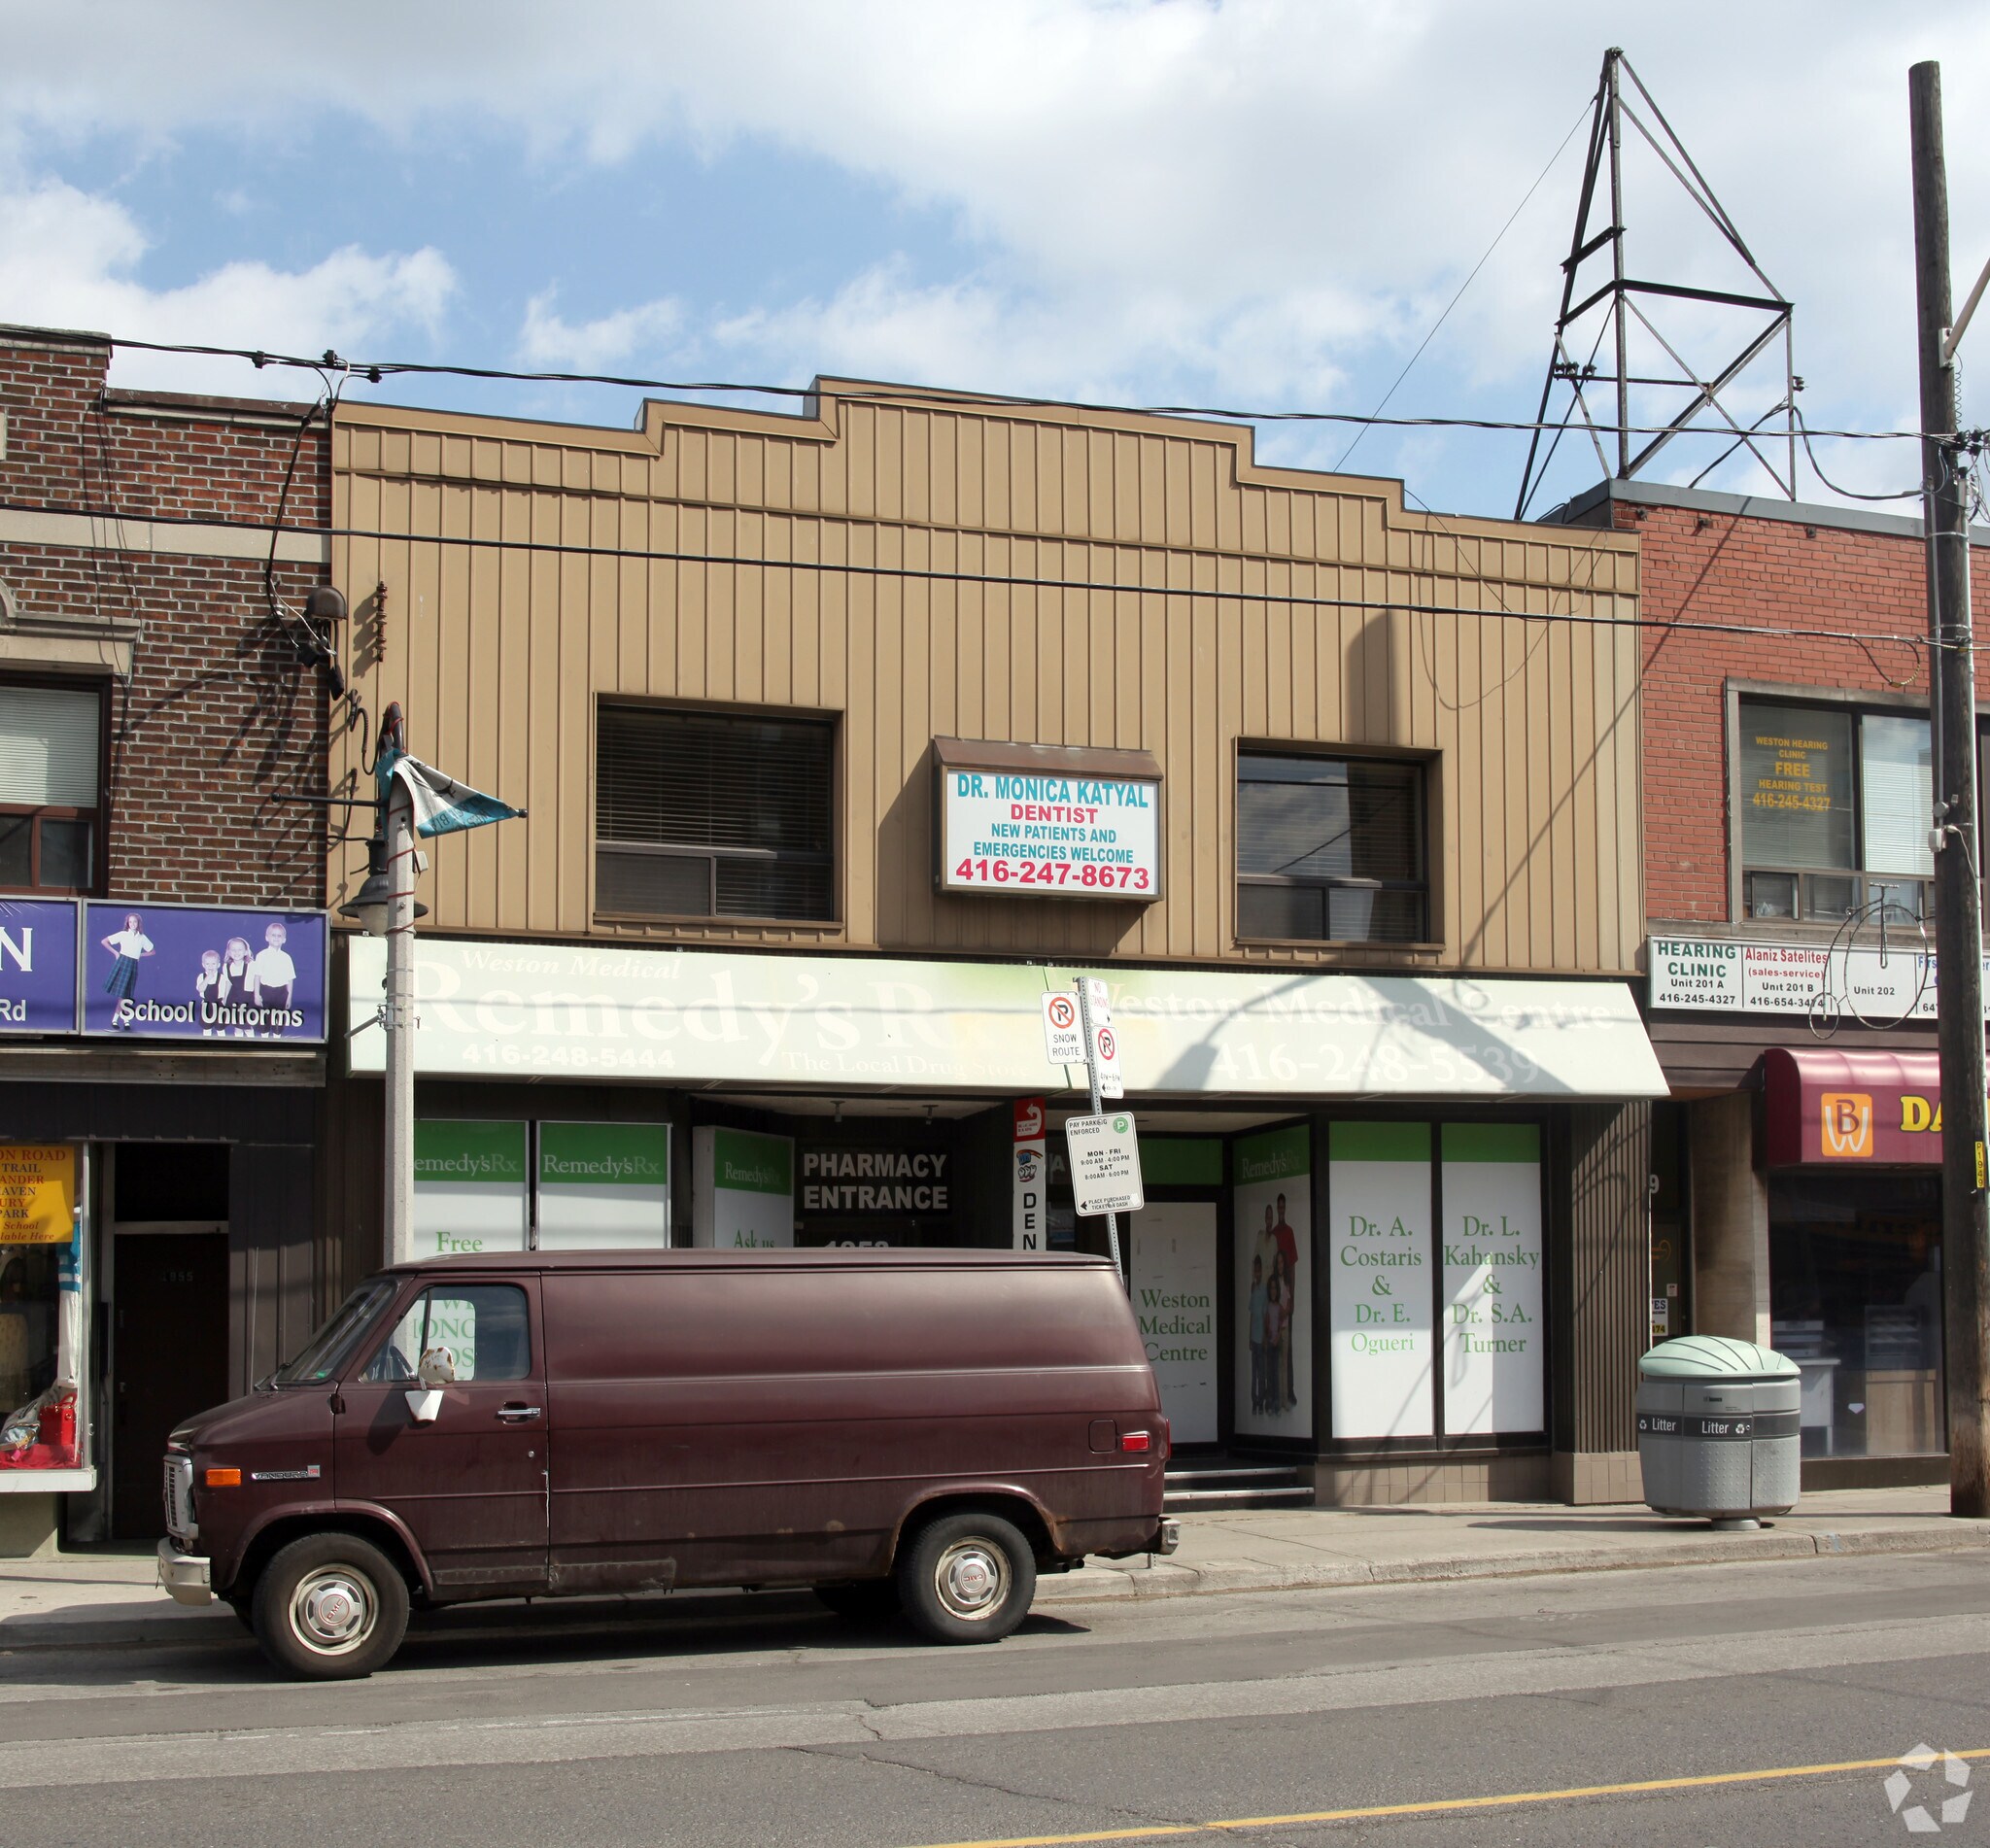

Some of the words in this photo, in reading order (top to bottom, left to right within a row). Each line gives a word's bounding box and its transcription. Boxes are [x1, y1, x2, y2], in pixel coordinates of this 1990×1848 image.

[1755, 736, 1790, 748] WESTON
[1791, 737, 1828, 750] HEARING
[1778, 749, 1806, 760] CLINIC
[1774, 762, 1811, 777] FREE
[957, 773, 989, 799] DR.
[995, 776, 1072, 804] MONICA
[1077, 780, 1149, 808] KATYAL
[1758, 778, 1801, 792] HEARING
[1803, 781, 1828, 793] TEST
[1752, 793, 1832, 811] 416-245-4327
[1011, 804, 1099, 824] DENTIST
[991, 823, 1021, 838] NEW
[1024, 825, 1086, 842] PATIENTS
[1089, 829, 1116, 843] AND
[974, 840, 1067, 861] EMERGENCIES
[1070, 846, 1134, 864] WELCOME
[955, 858, 1149, 890] 416-247-8673
[1658, 942, 1736, 960] HEARING
[1745, 947, 1777, 963] Alaniz
[1780, 948, 1829, 965] Satelites
[461, 949, 560, 975] Weston
[568, 955, 682, 979] Medical
[1667, 962, 1727, 978] CLINIC
[1748, 968, 1826, 980] (sales-service)
[1670, 978, 1693, 988] Unit
[1696, 979, 1714, 988] 201
[1717, 980, 1725, 989] A
[1762, 982, 1783, 992] Unit
[1786, 983, 1804, 992] 201
[1854, 986, 1876, 996] Unit
[1879, 986, 1896, 996] 202
[1257, 985, 1454, 1028] Medical
[1660, 993, 1735, 1005] 416-245-4327
[120, 998, 194, 1024] School
[200, 1001, 304, 1028] Uniforms
[1053, 1034, 1078, 1044] SNOW
[462, 1044, 676, 1070] 416-248-5444
[1051, 1046, 1081, 1057] ROUTE
[782, 1051, 832, 1073] The
[837, 1053, 901, 1075] Local
[905, 1056, 966, 1079] Drug
[1210, 1042, 1538, 1085] 416-248-5539
[1070, 1127, 1100, 1136] ENFORCED
[21, 1149, 66, 1161] ROAD
[2, 1163, 42, 1173] TRAIL
[803, 1153, 948, 1178] PHARMACY
[803, 1185, 948, 1210] ENTRANCE
[1104, 1195, 1130, 1204] PURCHASED
[3, 1221, 39, 1230] School
[1349, 1215, 1382, 1237] Dr.
[1389, 1215, 1413, 1237] A.
[1462, 1215, 1494, 1237] Dr.
[1500, 1215, 1521, 1237] L.
[30, 1232, 55, 1241] Here
[435, 1231, 483, 1252] Free
[735, 1229, 758, 1248] Ask
[762, 1239, 775, 1248] us
[1340, 1245, 1423, 1267] Costaris
[1444, 1244, 1540, 1271] Kahansky
[1371, 1275, 1392, 1296] &
[1482, 1274, 1503, 1295] &
[1139, 1288, 1211, 1309] Weston
[1355, 1303, 1386, 1323] Dr.
[1392, 1303, 1411, 1322] E.
[1452, 1303, 1483, 1324] Dr.
[1491, 1302, 1533, 1323] S.A.
[1138, 1314, 1213, 1335] Medical
[1145, 1342, 1208, 1361] Centre
[1351, 1332, 1415, 1356] Ogueri
[1458, 1332, 1527, 1354] Turner
[1652, 1418, 1677, 1432] Litter
[1701, 1420, 1730, 1434] Litter
[326, 1597, 345, 1621] GMC
